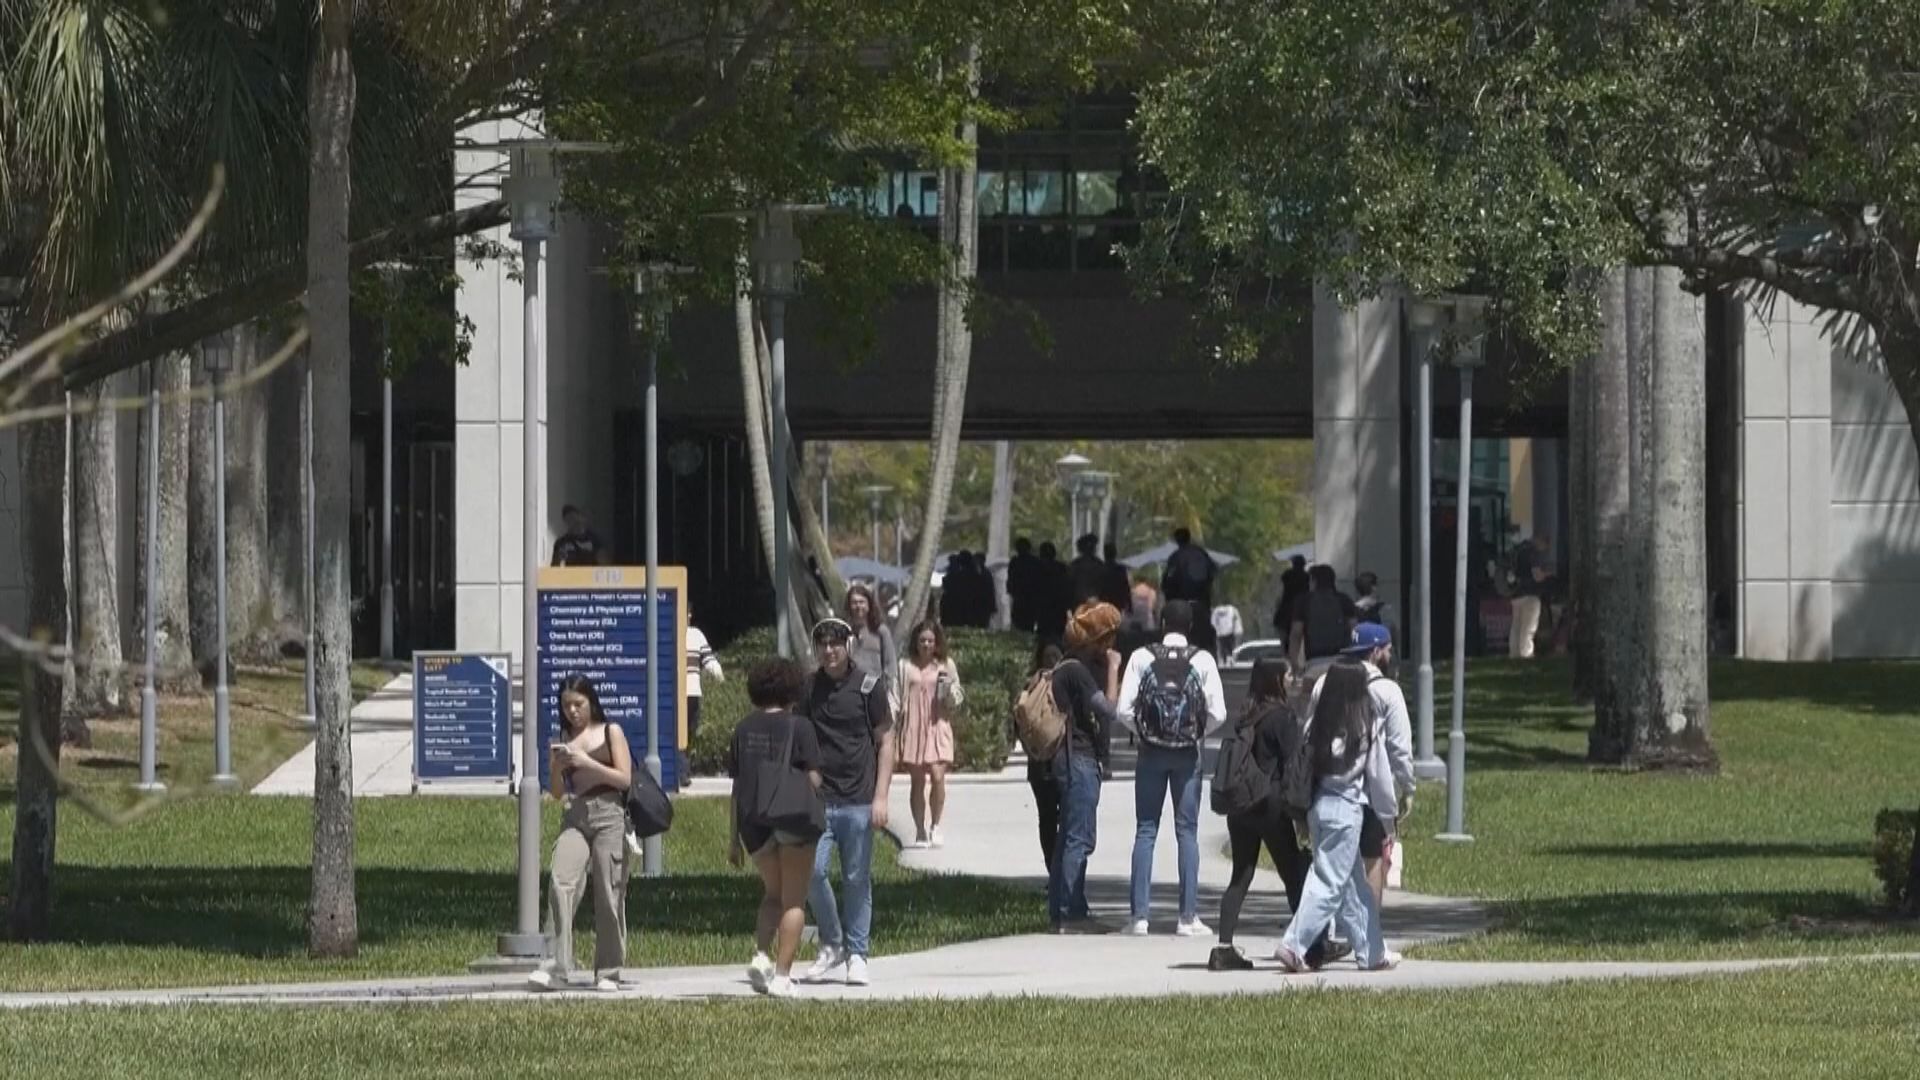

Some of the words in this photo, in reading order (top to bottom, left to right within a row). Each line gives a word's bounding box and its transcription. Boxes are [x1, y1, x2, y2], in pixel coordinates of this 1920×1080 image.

[549, 605, 587, 615] Chemistry
[588, 605, 595, 614] &
[595, 605, 625, 615] Physics
[551, 618, 574, 626] Green
[575, 617, 600, 627] Library
[549, 643, 580, 652] Graham
[580, 643, 605, 652] Center
[551, 657, 595, 667] Computing,
[596, 657, 614, 666] Arts,
[551, 670, 567, 679] and
